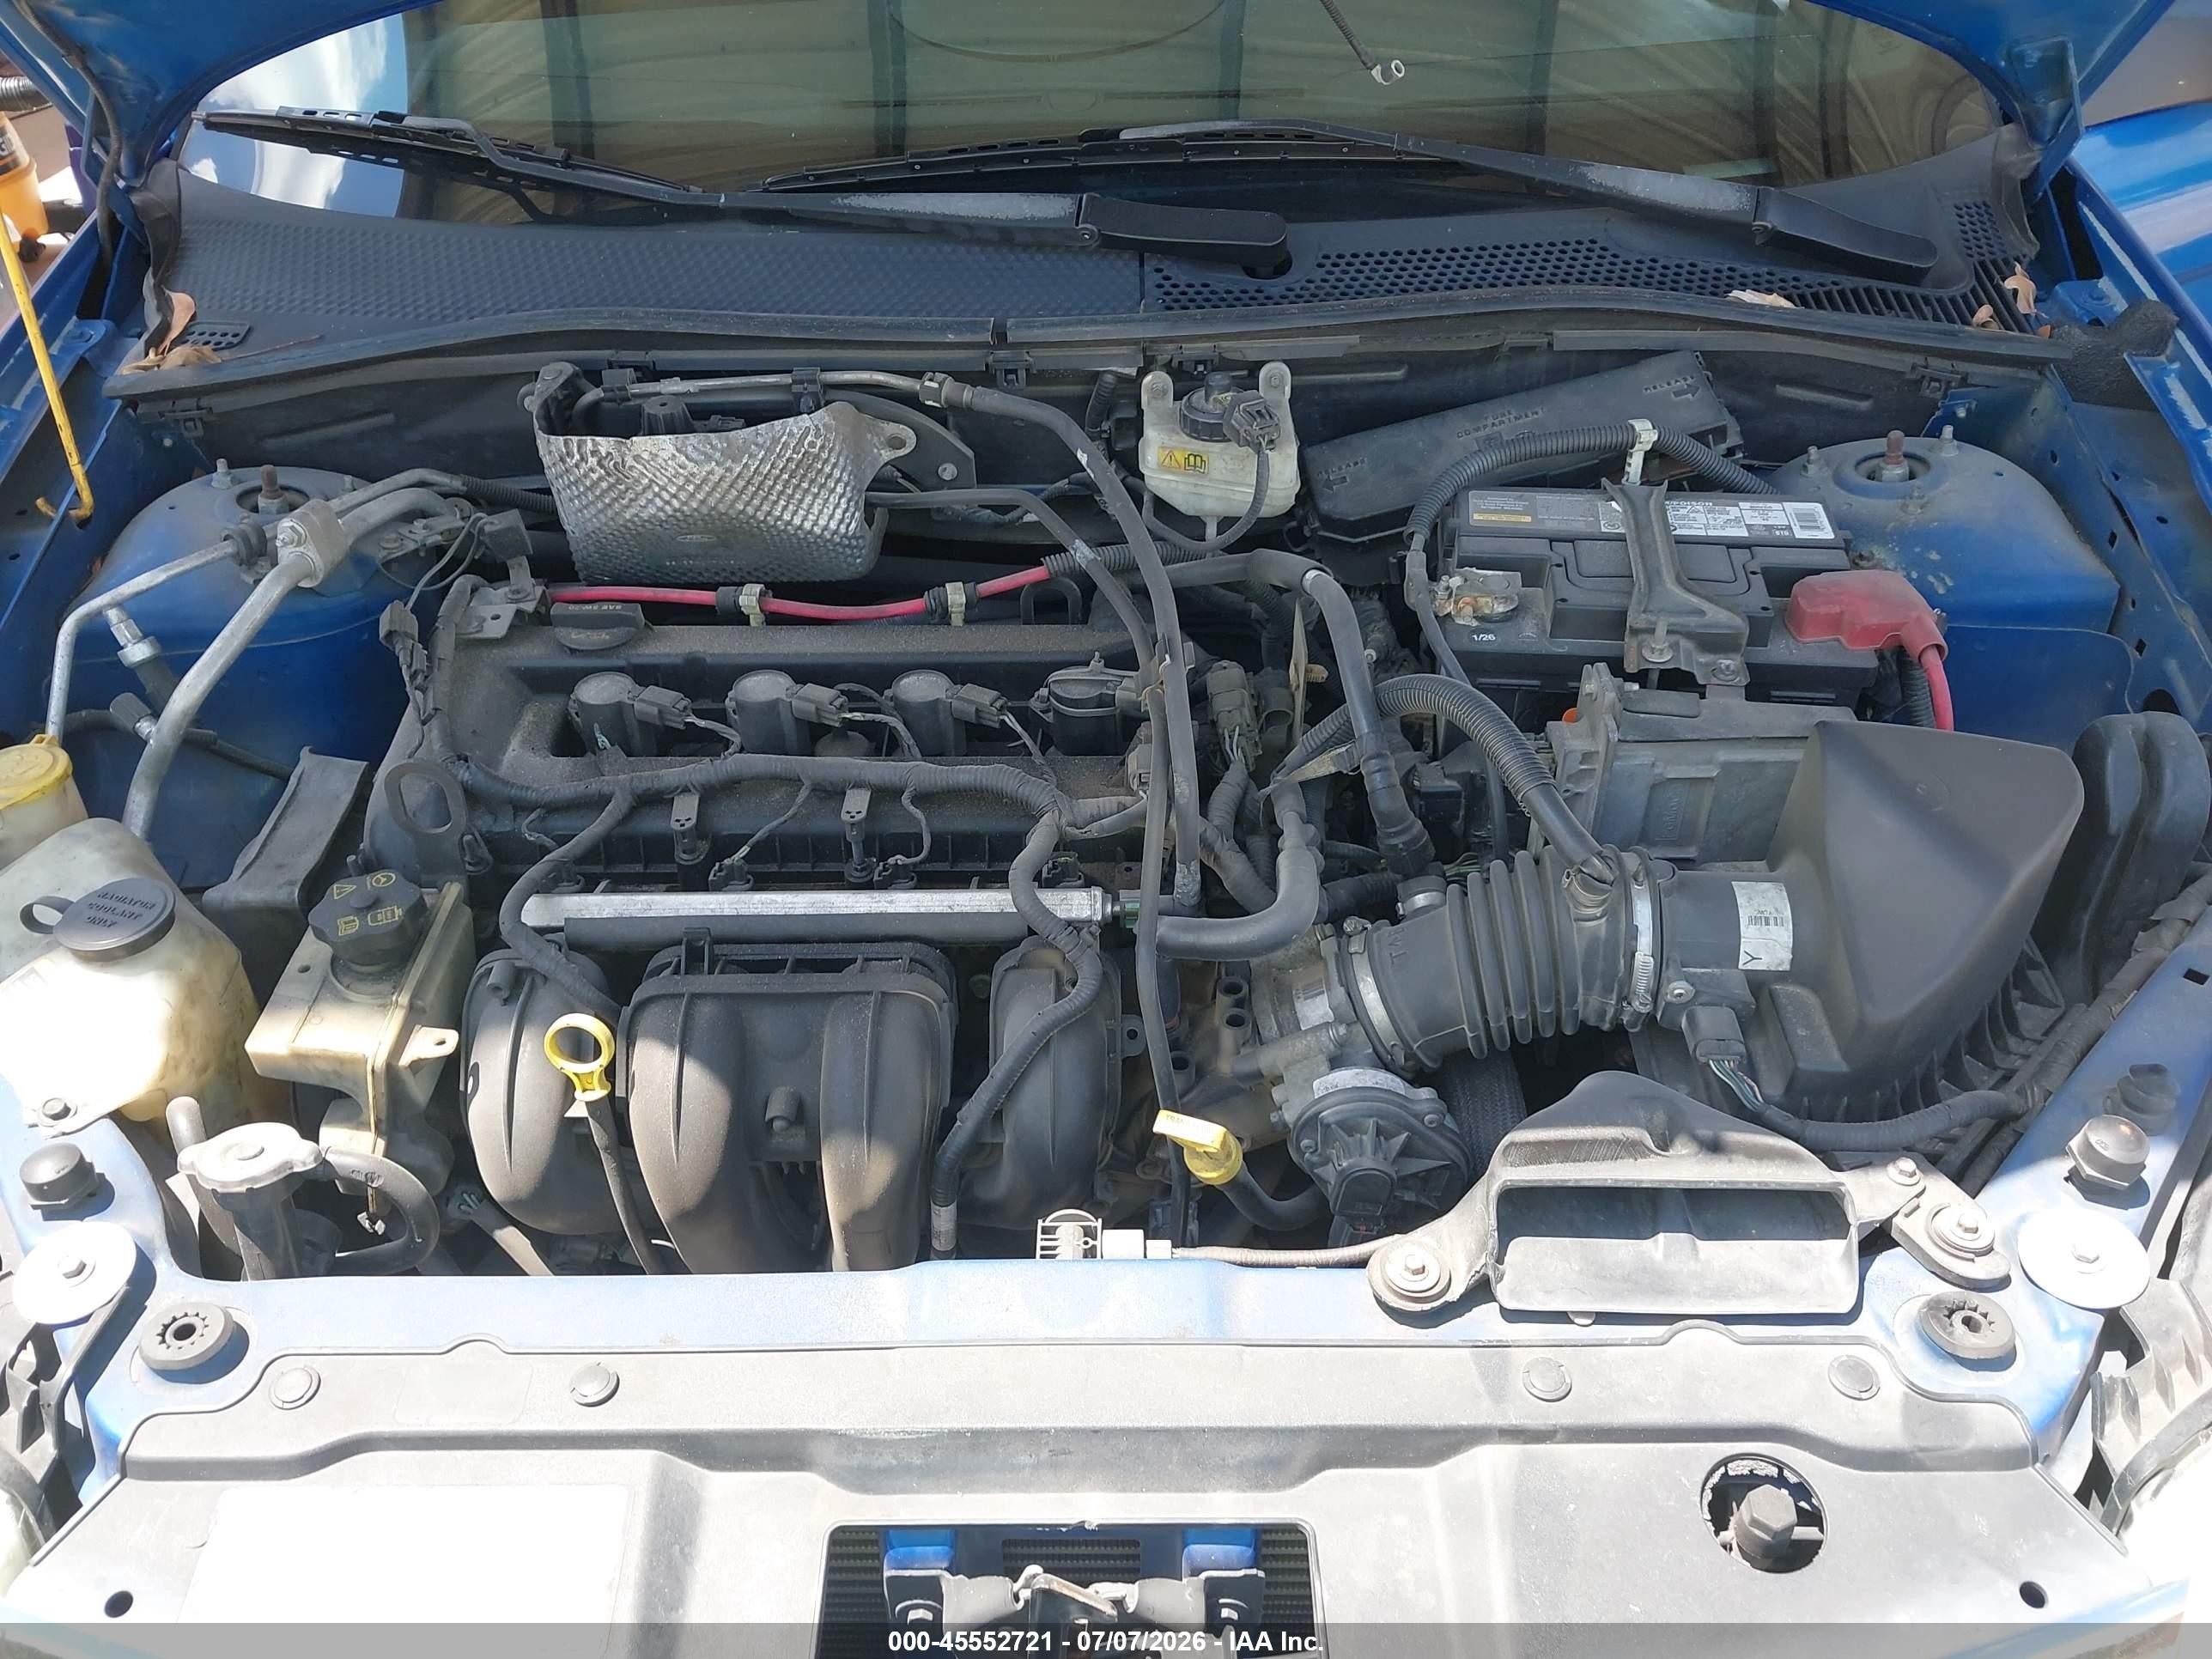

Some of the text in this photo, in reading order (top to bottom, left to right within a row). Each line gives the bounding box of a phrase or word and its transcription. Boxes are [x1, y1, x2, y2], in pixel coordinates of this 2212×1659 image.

[1643, 375, 1696, 393] RELEASE
[1455, 407, 1545, 439] COMPARTMENT
[1483, 409, 1512, 422] FUSE
[1316, 456, 1367, 477] RELEASE
[88, 902, 143, 921] COOLANT
[85, 915, 118, 928] ONLY
[1742, 950, 1763, 965] Y
